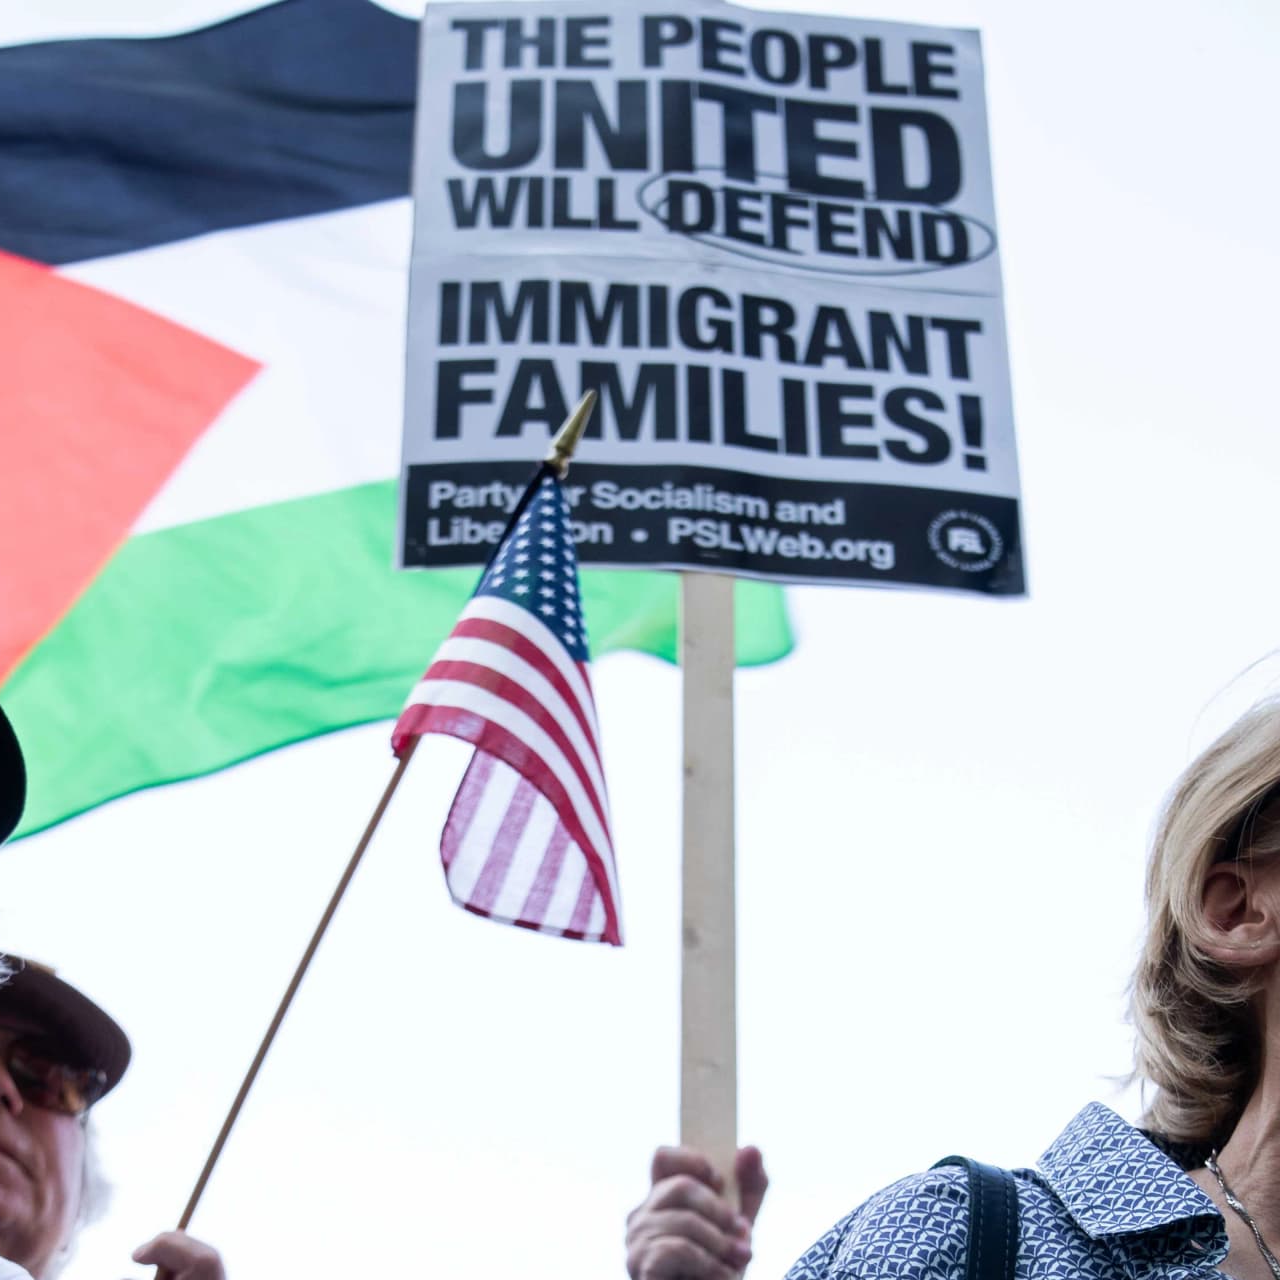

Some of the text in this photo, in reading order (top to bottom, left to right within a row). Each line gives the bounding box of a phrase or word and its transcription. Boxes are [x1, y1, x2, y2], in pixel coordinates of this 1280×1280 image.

[450, 15, 960, 100] THE PEOPLE
[452, 79, 963, 206] UNITED
[446, 176, 968, 266] WILL DEFEND
[438, 280, 982, 380] IMMIGRANT
[434, 358, 988, 471] FAMILIES!
[427, 516, 614, 546] Libeon
[668, 517, 897, 570] PSLWeb.org
[428, 480, 525, 514] Party
[591, 481, 769, 519] Socialism
[775, 498, 846, 525] and
